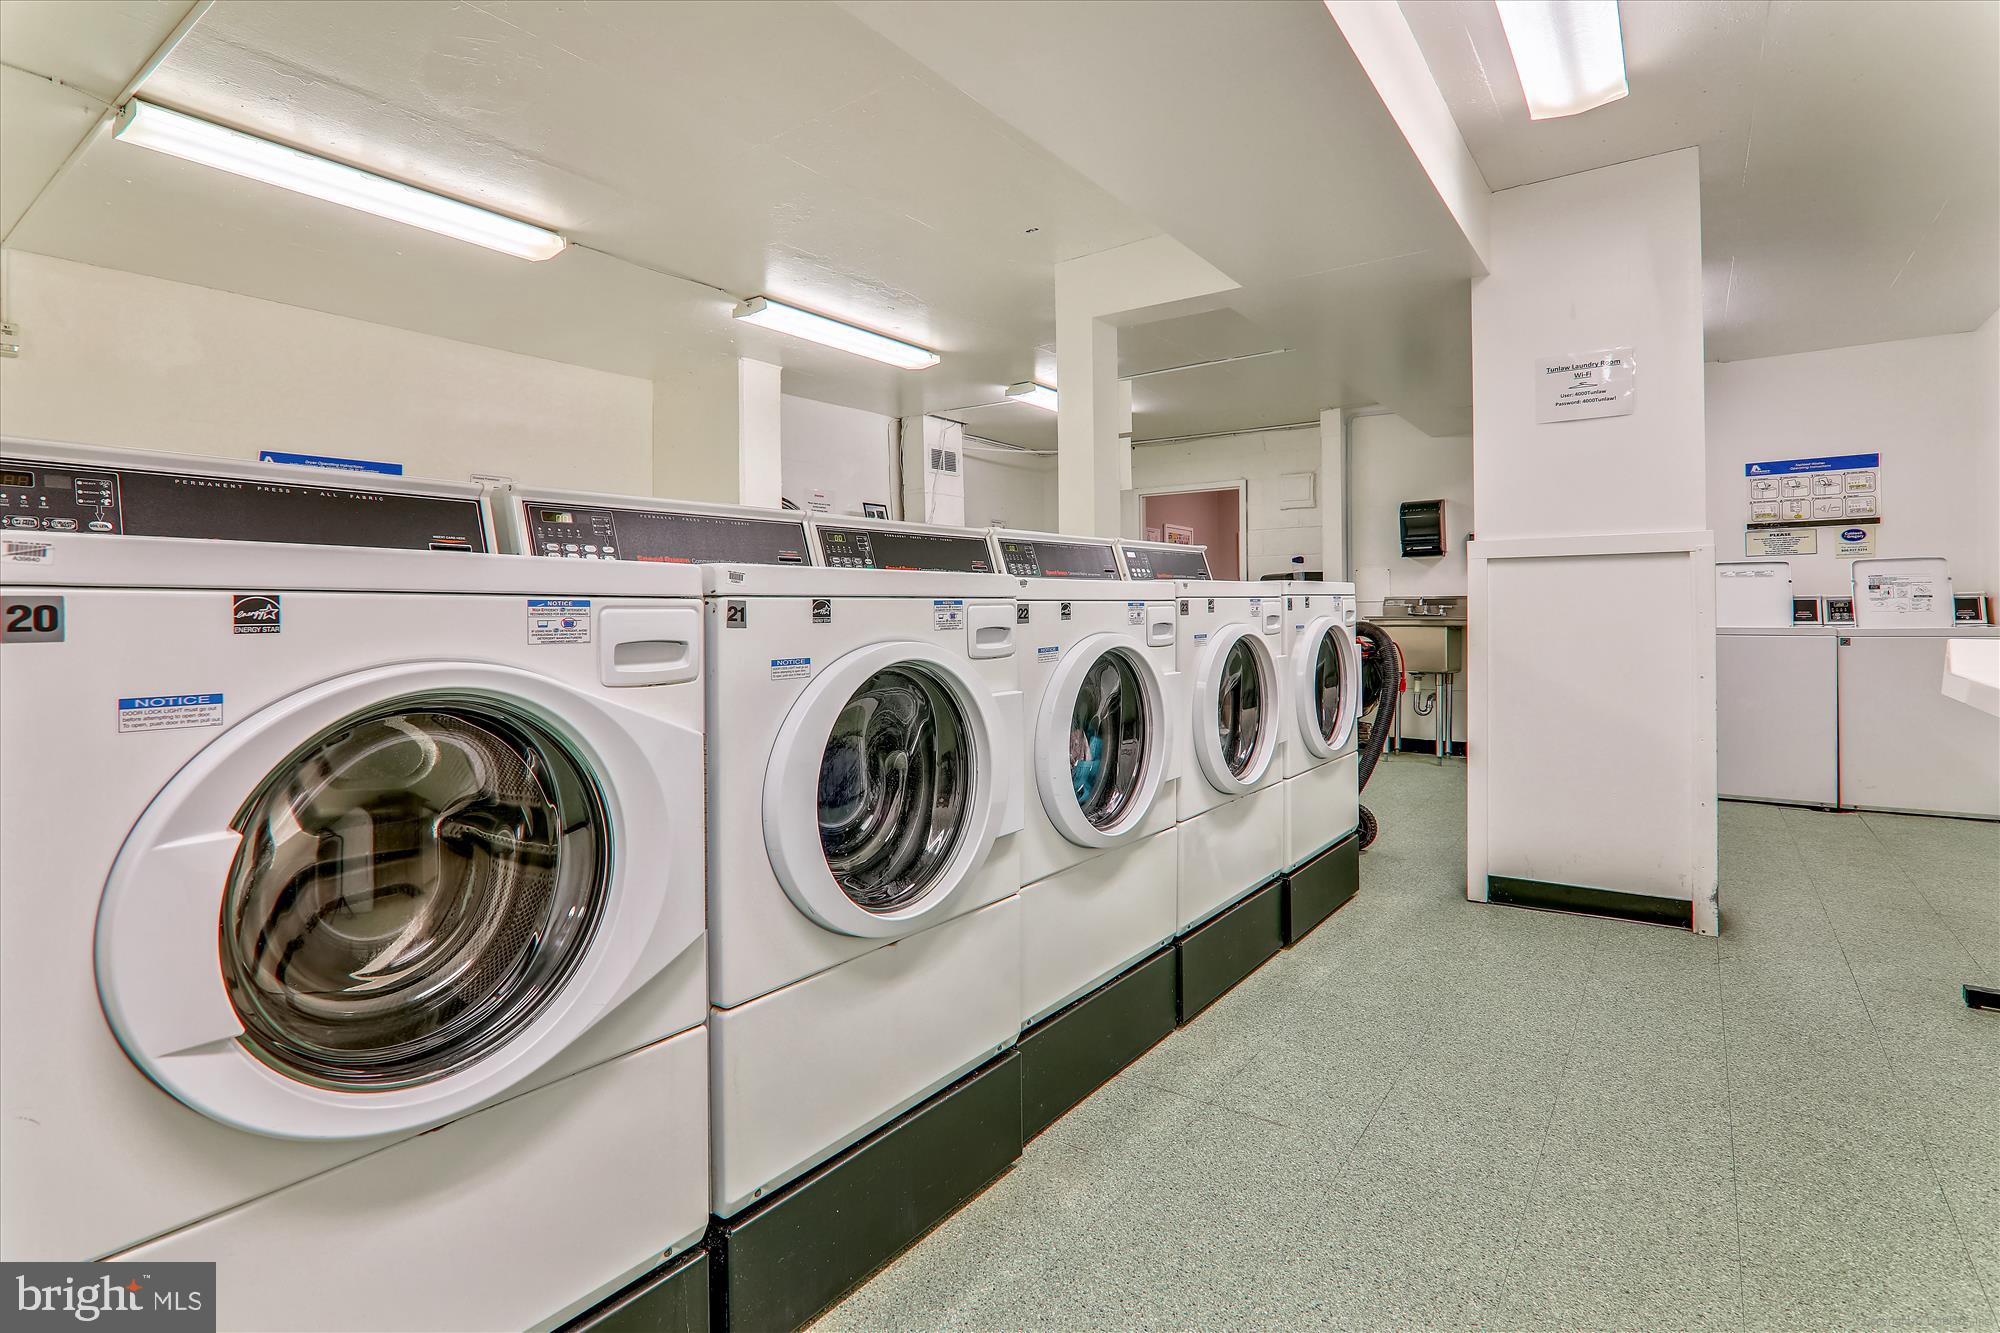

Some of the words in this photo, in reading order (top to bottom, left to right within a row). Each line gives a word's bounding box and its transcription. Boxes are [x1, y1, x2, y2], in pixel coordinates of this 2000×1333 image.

[1546, 365, 1570, 373] Tunlaw
[1571, 361, 1599, 370] Laundry
[1573, 370, 1592, 378] Wi-Fi
[1555, 399, 1581, 407] Password:
[174, 478, 243, 489] PERMANENT
[257, 485, 291, 494] PRESS
[349, 493, 385, 502] FABRIC
[6, 604, 59, 632] 20
[727, 605, 745, 622] 21
[1017, 607, 1029, 620] 22
[777, 658, 806, 666] NOTICE
[135, 695, 210, 708] NOTICE
[142, 714, 174, 722] attempting
[149, 720, 164, 728] push
[165, 718, 179, 726] door
[186, 717, 199, 725] then
[200, 716, 211, 724] pull
